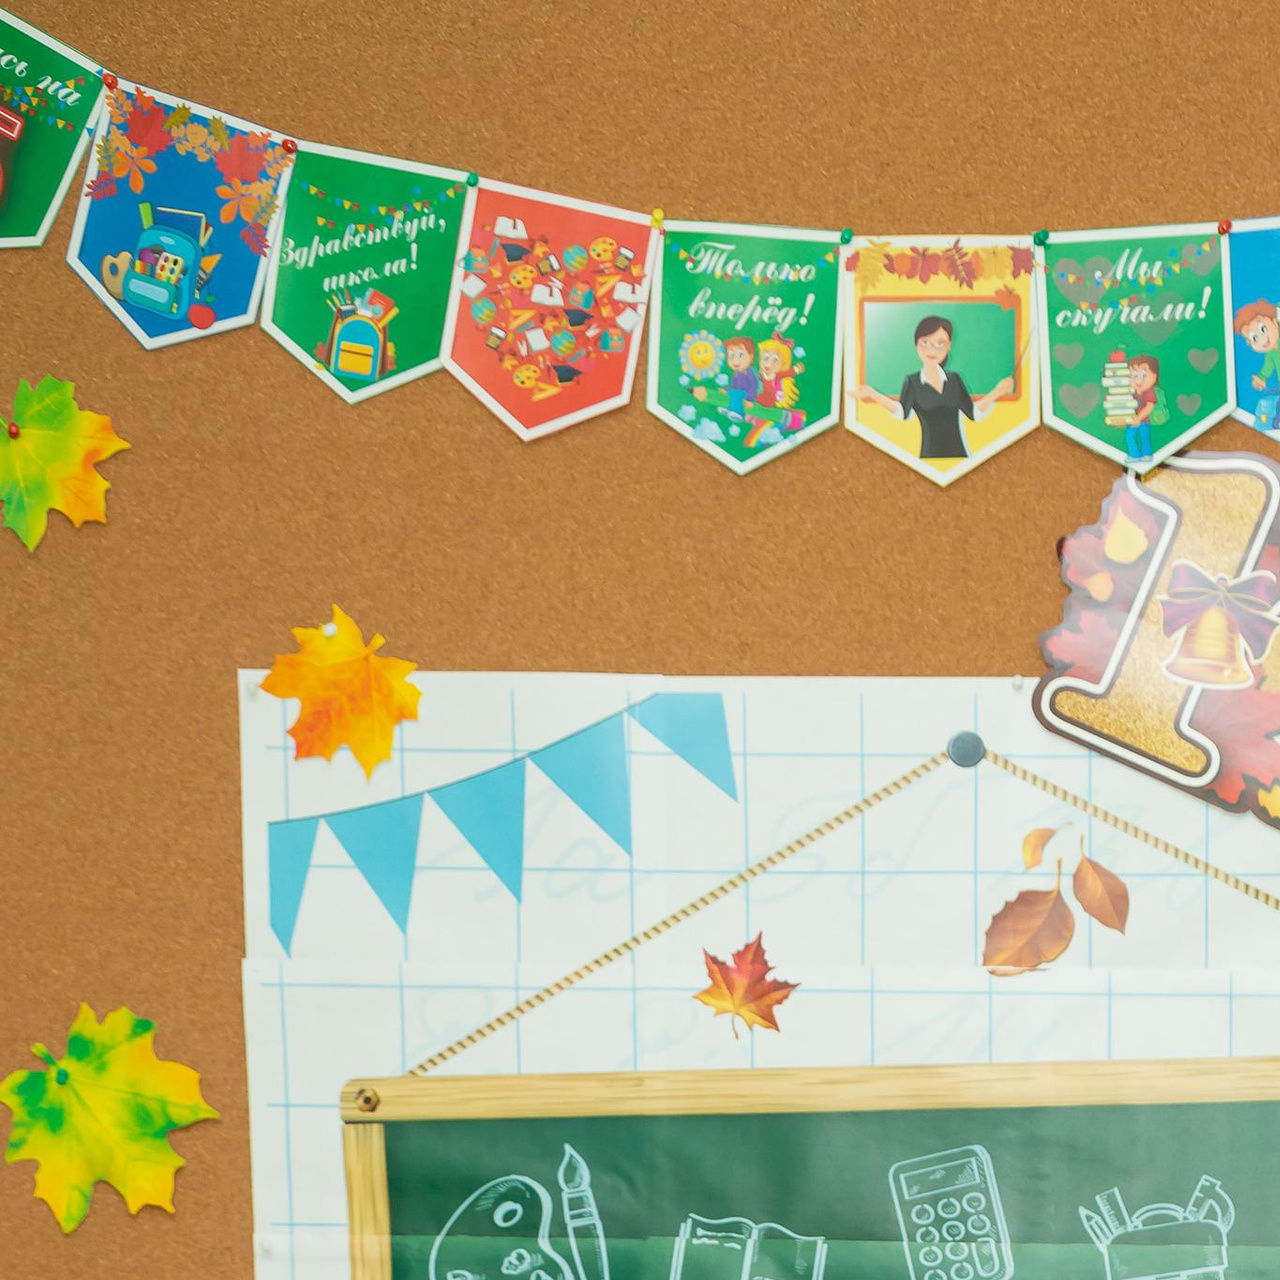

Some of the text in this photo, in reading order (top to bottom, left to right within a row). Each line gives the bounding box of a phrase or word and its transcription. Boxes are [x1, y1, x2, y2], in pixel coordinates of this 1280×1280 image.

[0, 48, 82, 106] сь на
[277, 205, 447, 271] Здравствуй,
[685, 241, 817, 281] Только
[322, 242, 418, 292] школа!
[1094, 247, 1164, 281] Мы
[688, 286, 815, 333] вперёд!
[1055, 286, 1212, 335] скучали!
[1041, 456, 1280, 787] 1
